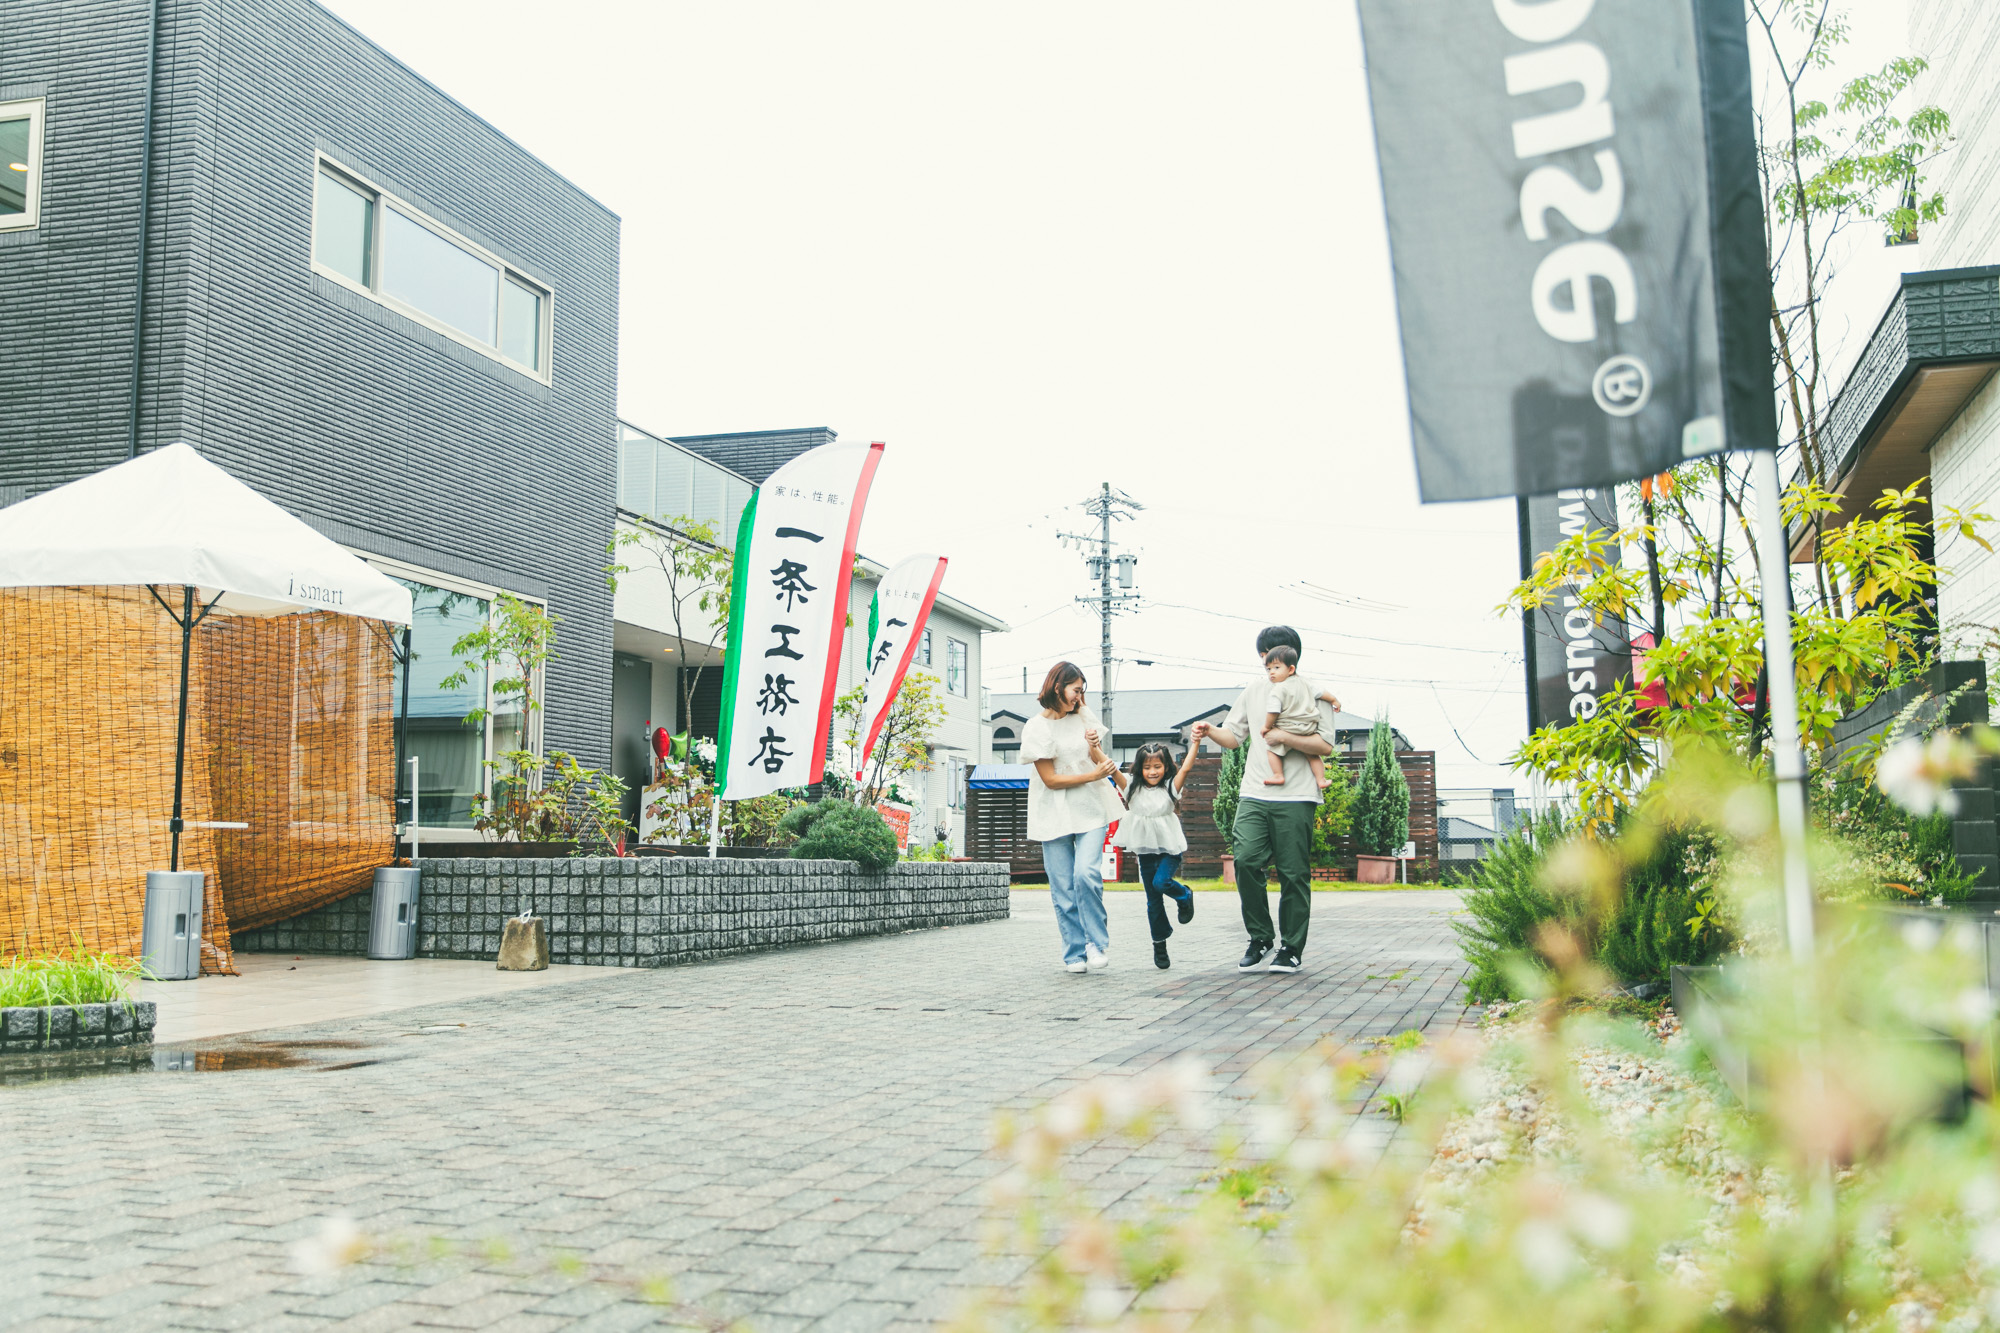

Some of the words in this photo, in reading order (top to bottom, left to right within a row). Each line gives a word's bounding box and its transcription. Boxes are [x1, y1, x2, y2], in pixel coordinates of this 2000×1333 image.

[748, 527, 824, 774] 一条工務店
